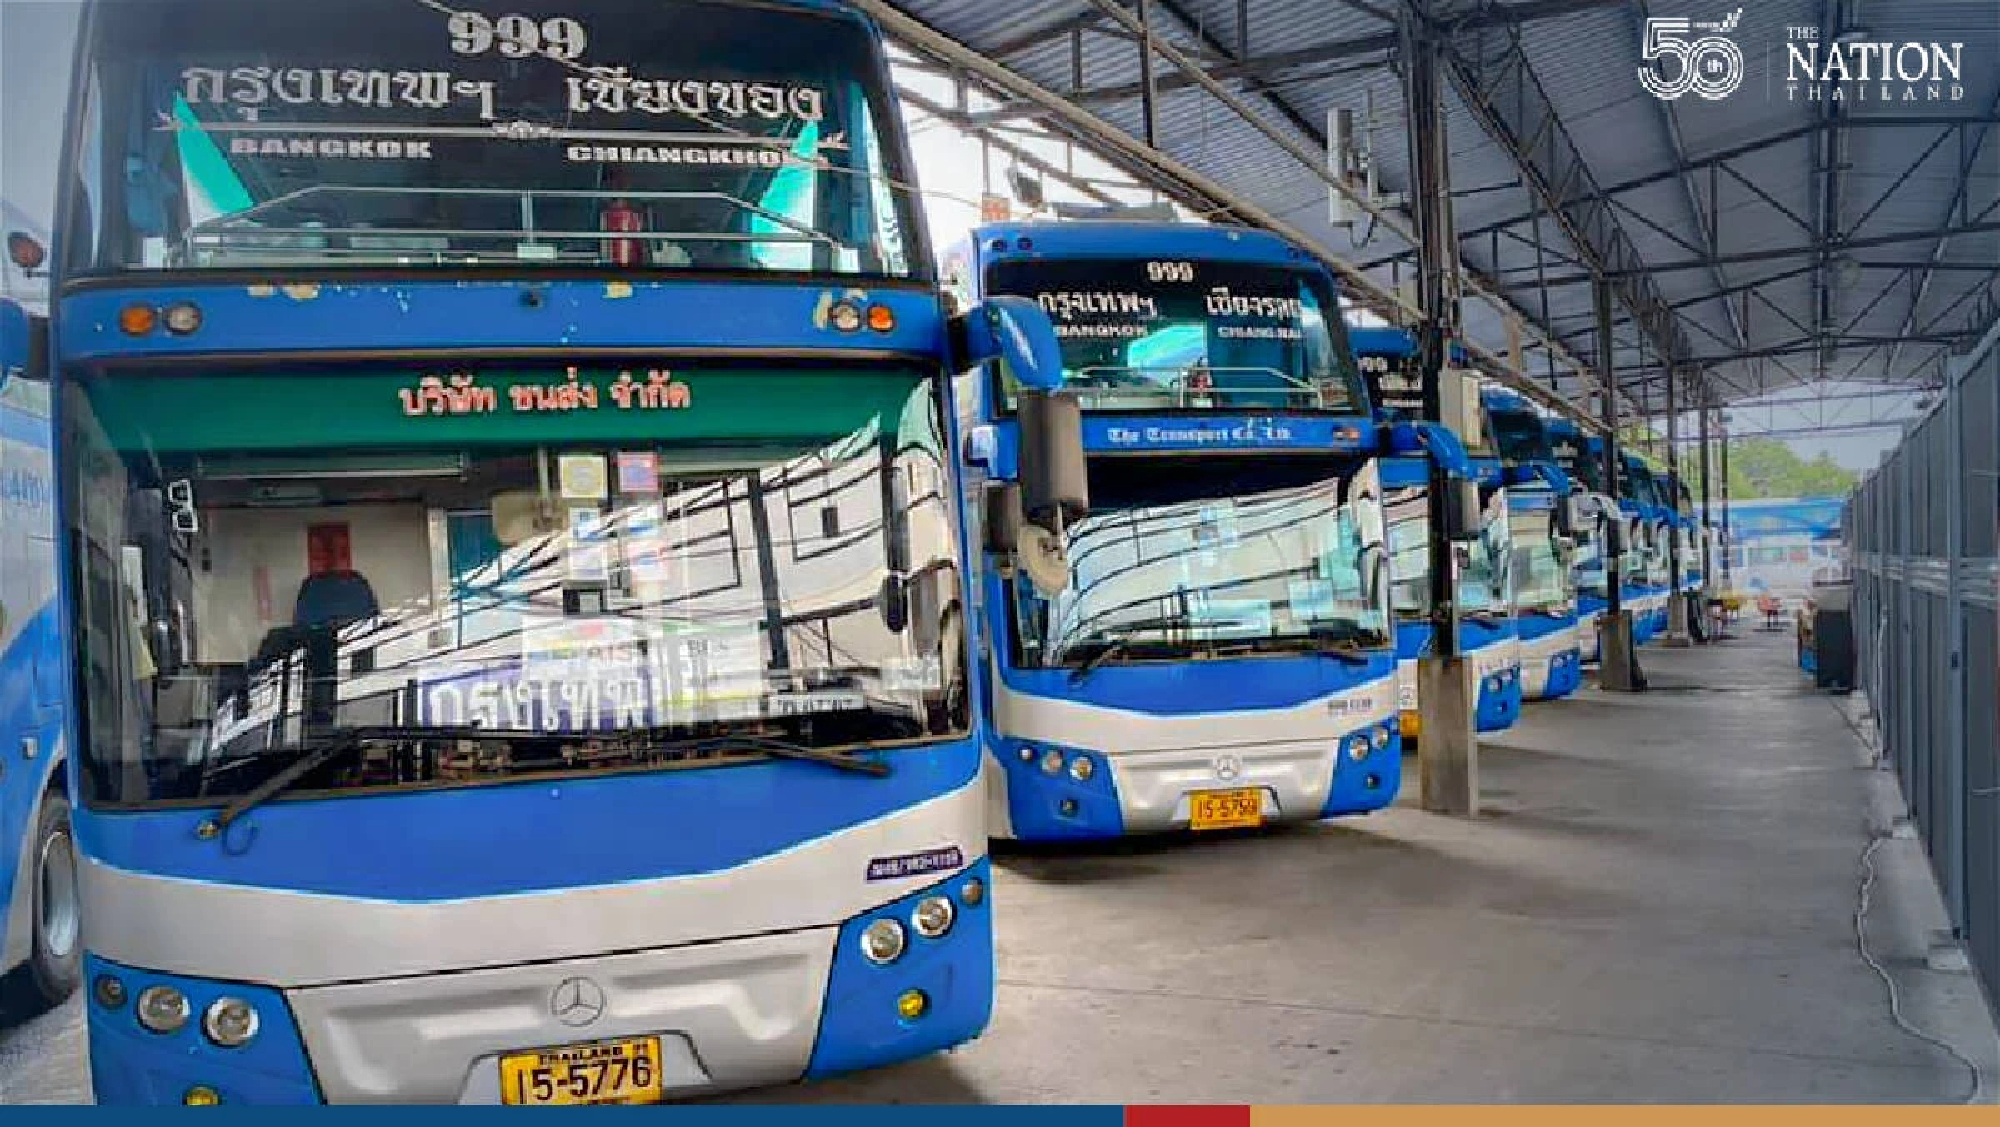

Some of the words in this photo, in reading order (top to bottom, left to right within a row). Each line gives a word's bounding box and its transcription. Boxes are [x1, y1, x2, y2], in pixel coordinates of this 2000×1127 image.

[448, 12, 588, 60] 999
[182, 66, 497, 121] กรุงเทพฯ
[566, 66, 824, 121] เชียงของ
[230, 138, 433, 158] BANGKOK
[1147, 262, 1194, 282] 999
[398, 374, 498, 416] บริษัท
[508, 366, 598, 412] ขนส่ง
[609, 370, 691, 409] จำกัด
[518, 1057, 653, 1105] 15-5776
